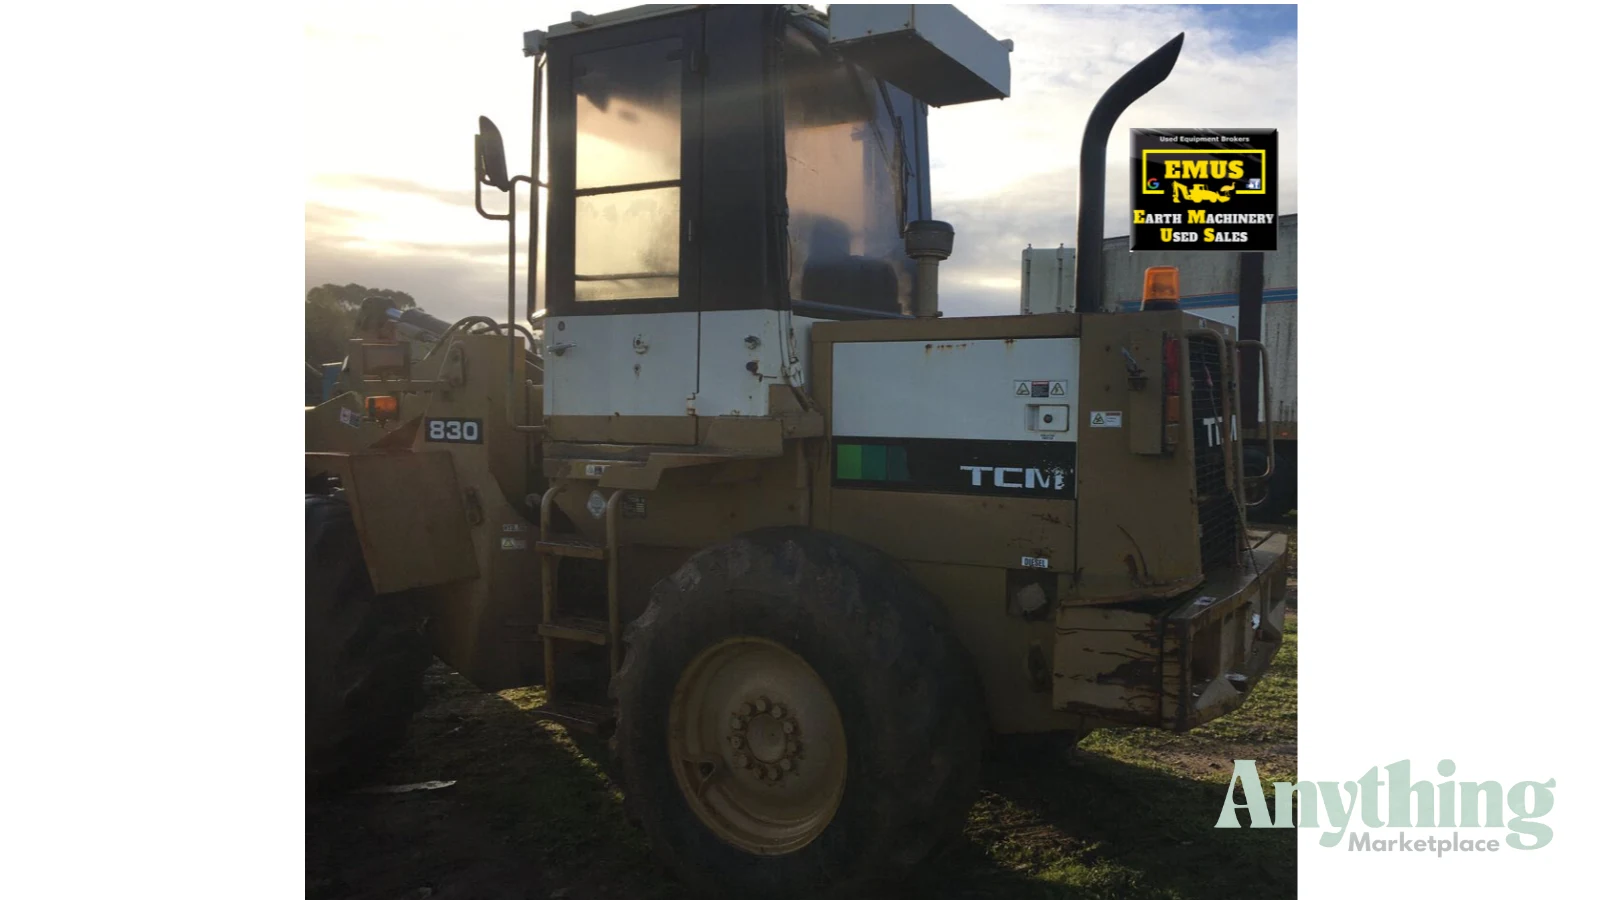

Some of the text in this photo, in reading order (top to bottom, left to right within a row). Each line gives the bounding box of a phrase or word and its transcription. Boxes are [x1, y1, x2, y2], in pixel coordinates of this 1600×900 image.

[429, 420, 478, 441] 830
[960, 465, 1067, 490] TCM
[1024, 557, 1046, 568] DIESEL
